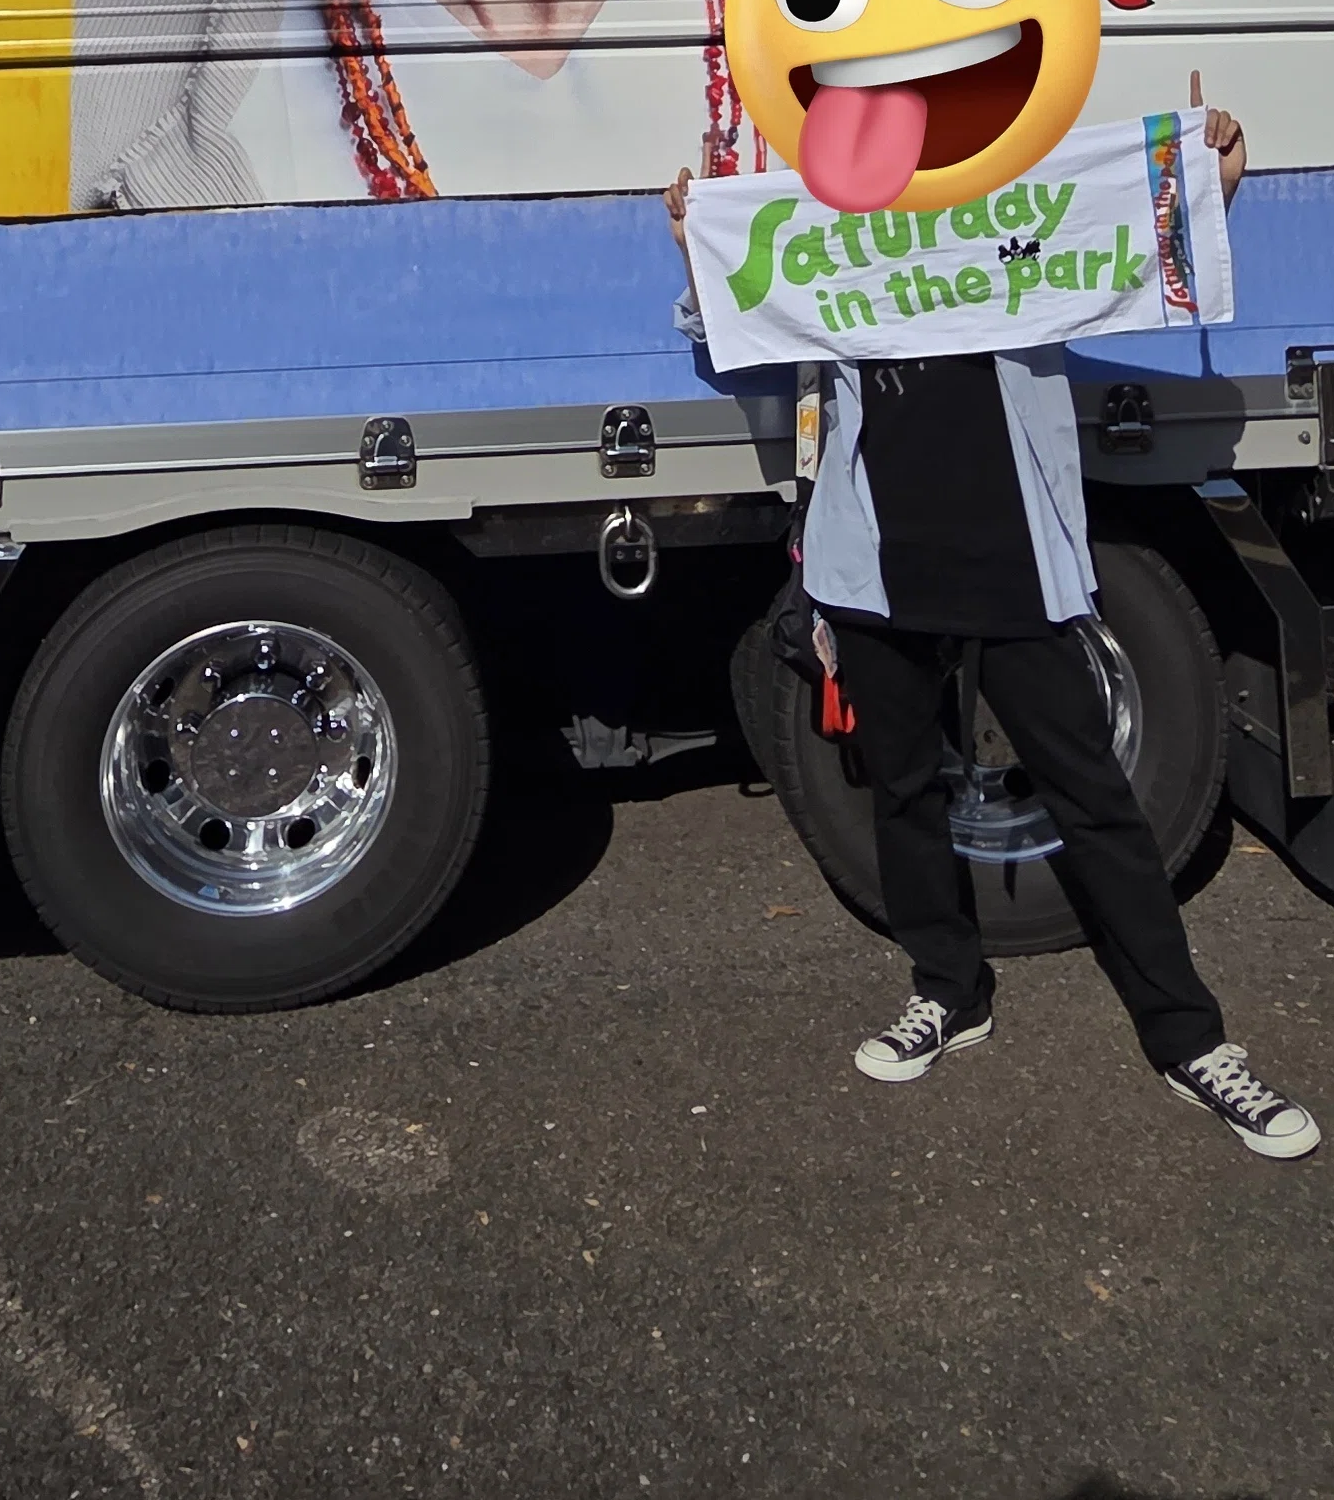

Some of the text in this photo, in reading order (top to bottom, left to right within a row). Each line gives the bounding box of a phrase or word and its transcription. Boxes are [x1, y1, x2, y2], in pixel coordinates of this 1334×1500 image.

[726, 182, 1078, 313] Saturday
[815, 289, 879, 333] in
[884, 264, 992, 318] the
[1005, 224, 1148, 315] park
